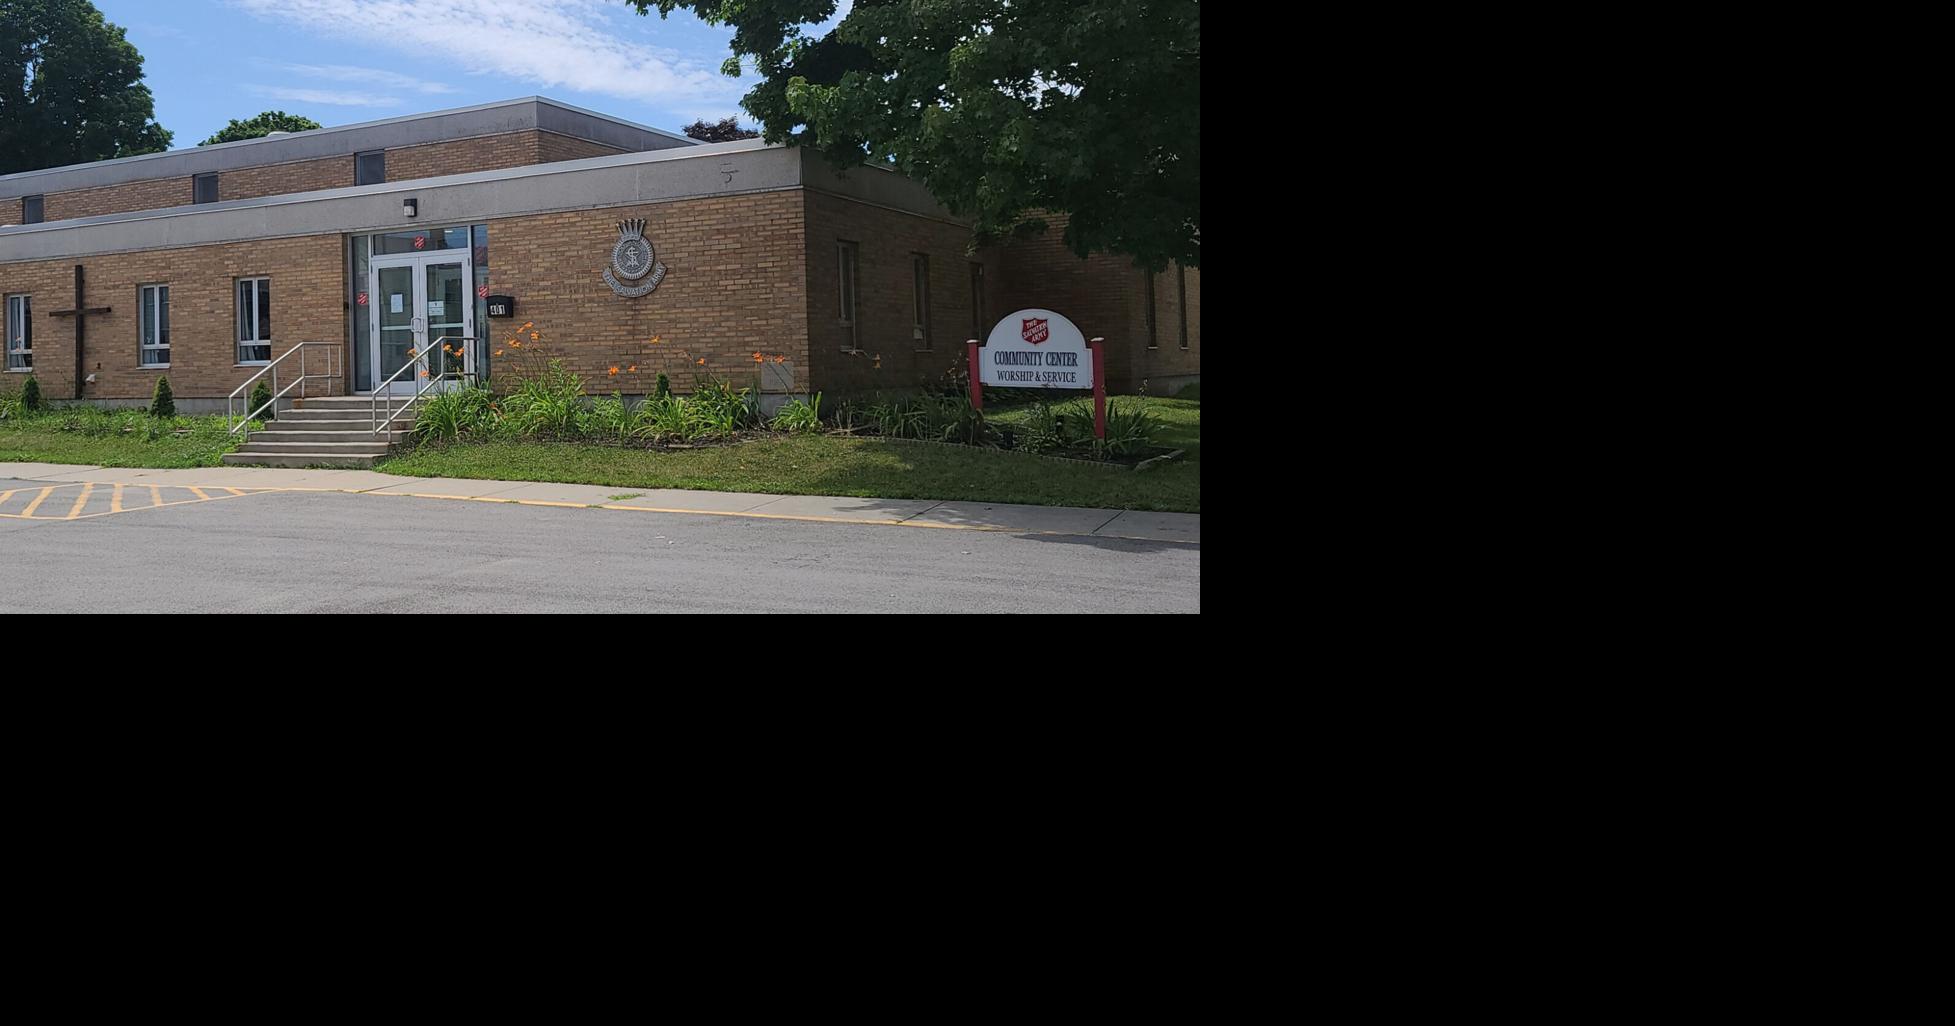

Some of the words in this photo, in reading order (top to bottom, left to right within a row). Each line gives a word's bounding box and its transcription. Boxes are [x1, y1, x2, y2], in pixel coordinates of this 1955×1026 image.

[652, 264, 667, 284] ARMY
[1026, 320, 1038, 330] THE
[1031, 329, 1047, 343] ARMY
[994, 351, 1043, 366] COMMUNITY
[1045, 352, 1078, 367] CENTER
[997, 370, 1034, 382] WORSHIP
[1035, 373, 1041, 382] &
[1042, 372, 1077, 383] SERVICE
